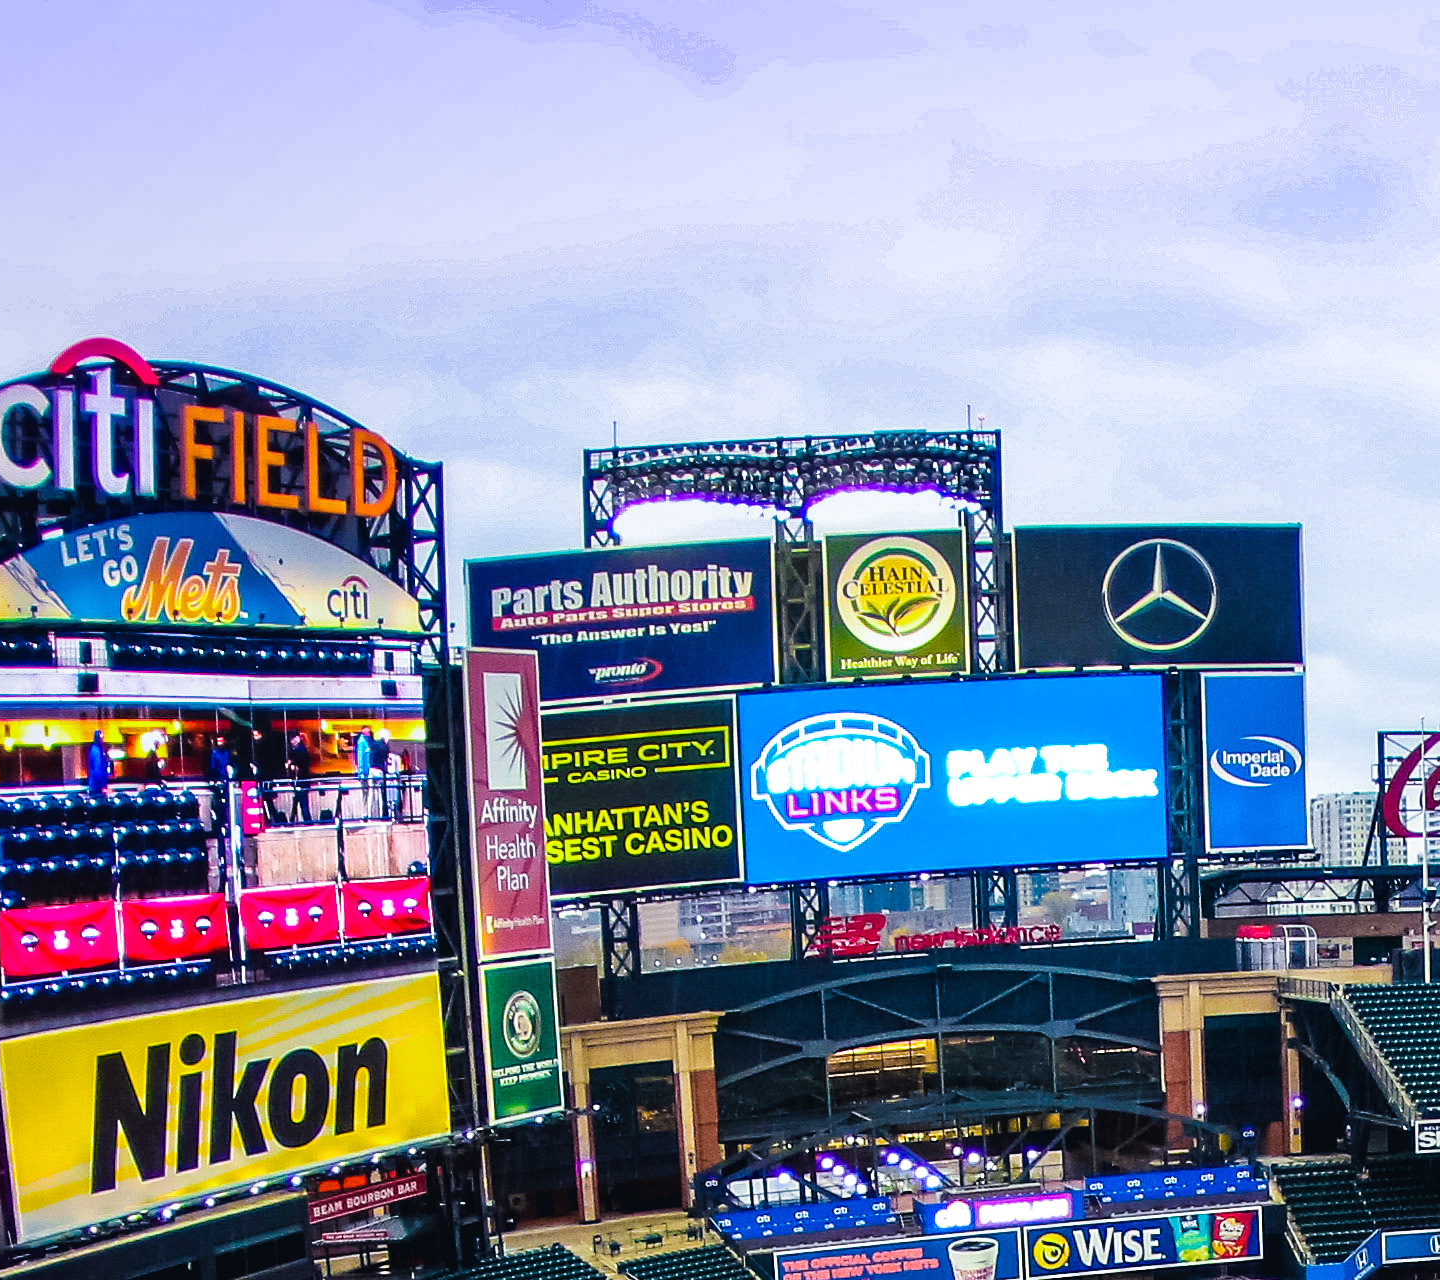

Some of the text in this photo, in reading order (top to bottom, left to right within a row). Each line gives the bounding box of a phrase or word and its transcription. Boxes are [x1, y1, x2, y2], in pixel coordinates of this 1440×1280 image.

[180, 404, 398, 518] FIELD
[59, 522, 134, 567] LET'S
[101, 535, 242, 623] GO Mets
[842, 576, 950, 600] CELESTIAL
[868, 563, 924, 585] HAIN
[327, 579, 370, 621] citi
[491, 564, 754, 618] Parts Authority
[500, 599, 747, 630] Auto Parts Super Stores
[576, 625, 646, 643] Answer
[649, 623, 667, 637] Is
[593, 660, 648, 682] pronto
[840, 652, 962, 671] Healthier Way of Life
[766, 737, 917, 795] STADIUM
[947, 746, 1034, 778] PLAY
[1221, 749, 1285, 768] Imperial
[1250, 762, 1292, 779] Dade
[567, 766, 648, 784] CASINO
[481, 797, 538, 829] Affinity
[786, 786, 901, 818] LINKS
[486, 833, 537, 862] Health
[625, 824, 734, 855] CASINO
[496, 865, 530, 892] Plan
[90, 1028, 389, 1195] Nikon
[312, 1180, 418, 1218] BEAM BOURBON BAR
